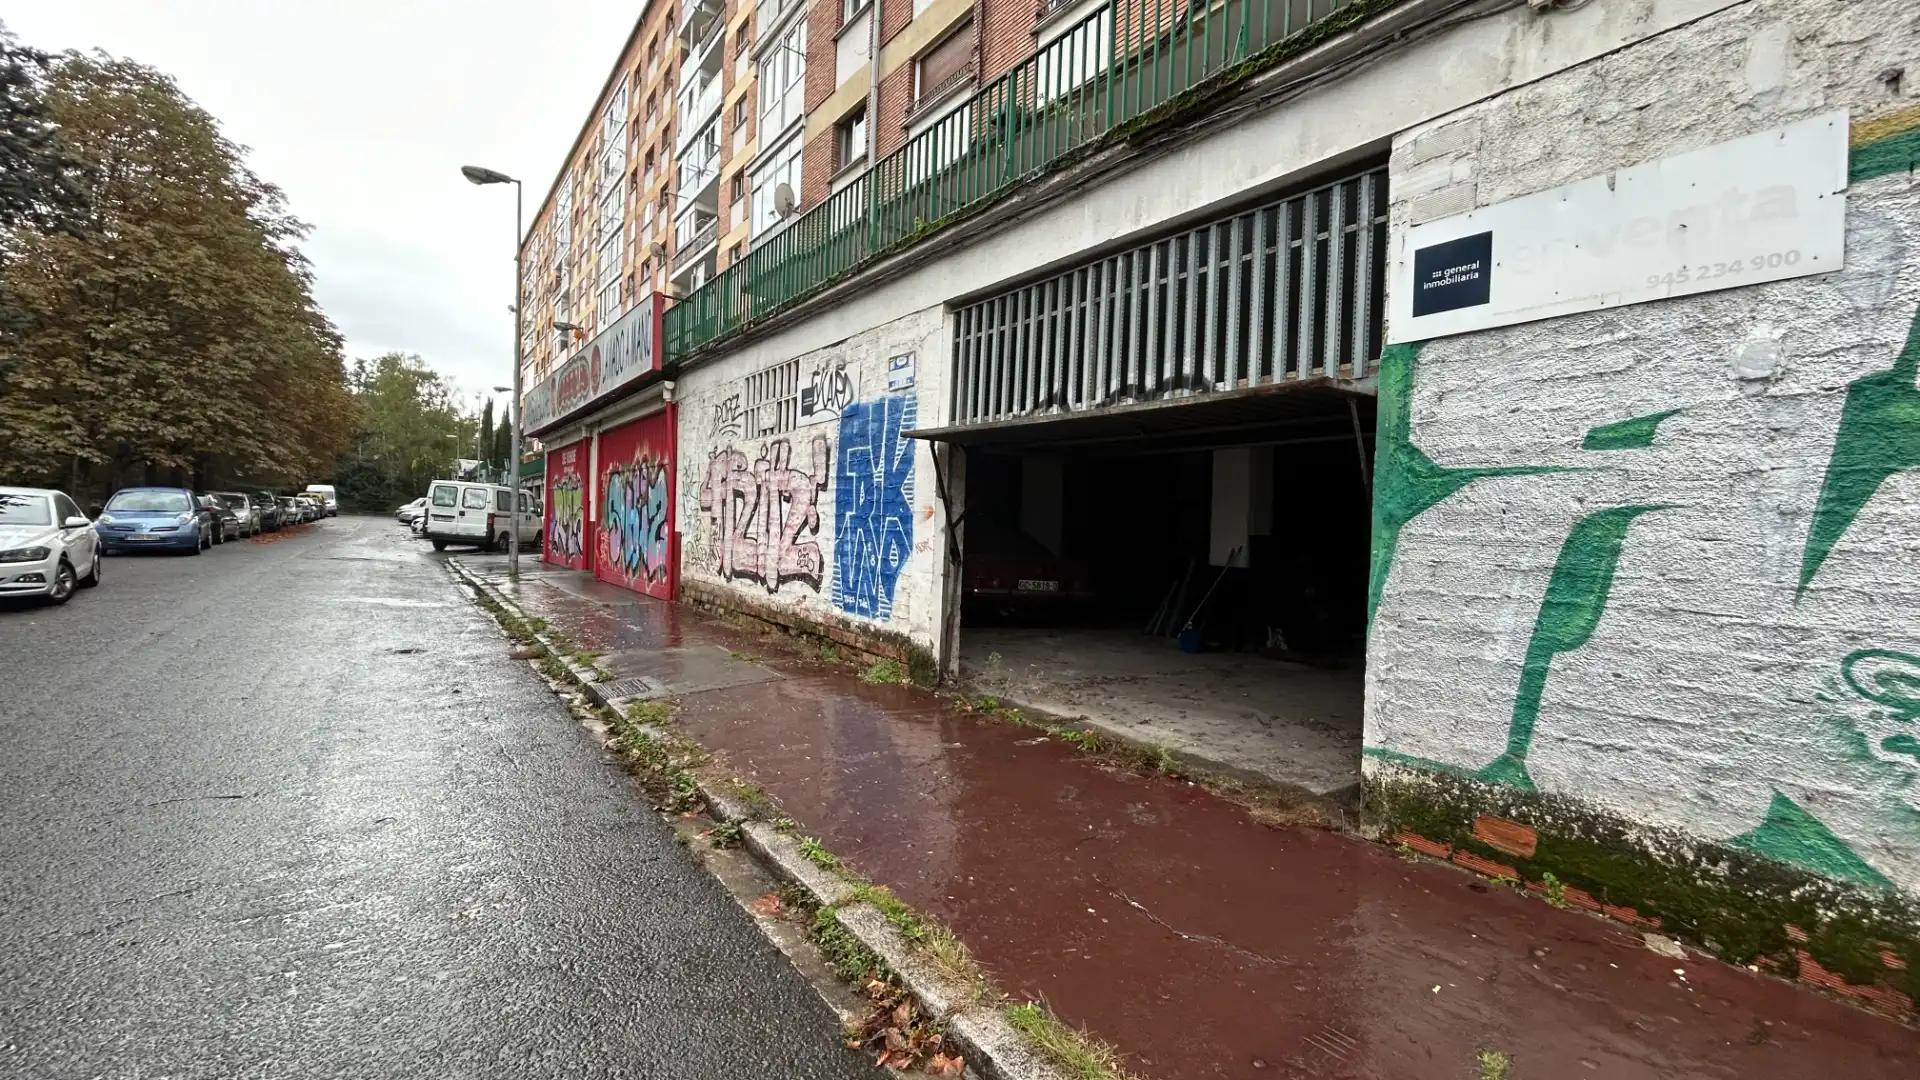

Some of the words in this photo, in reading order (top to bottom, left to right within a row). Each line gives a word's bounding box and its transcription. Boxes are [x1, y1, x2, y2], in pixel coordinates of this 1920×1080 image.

[1512, 237, 1566, 275] en
[1580, 183, 1800, 257] venta
[1423, 271, 1479, 290] inmobiliaria
[1444, 260, 1480, 277] general
[1646, 269, 1690, 289] 945
[1696, 259, 1744, 281] 234
[1750, 249, 1801, 271] 900
